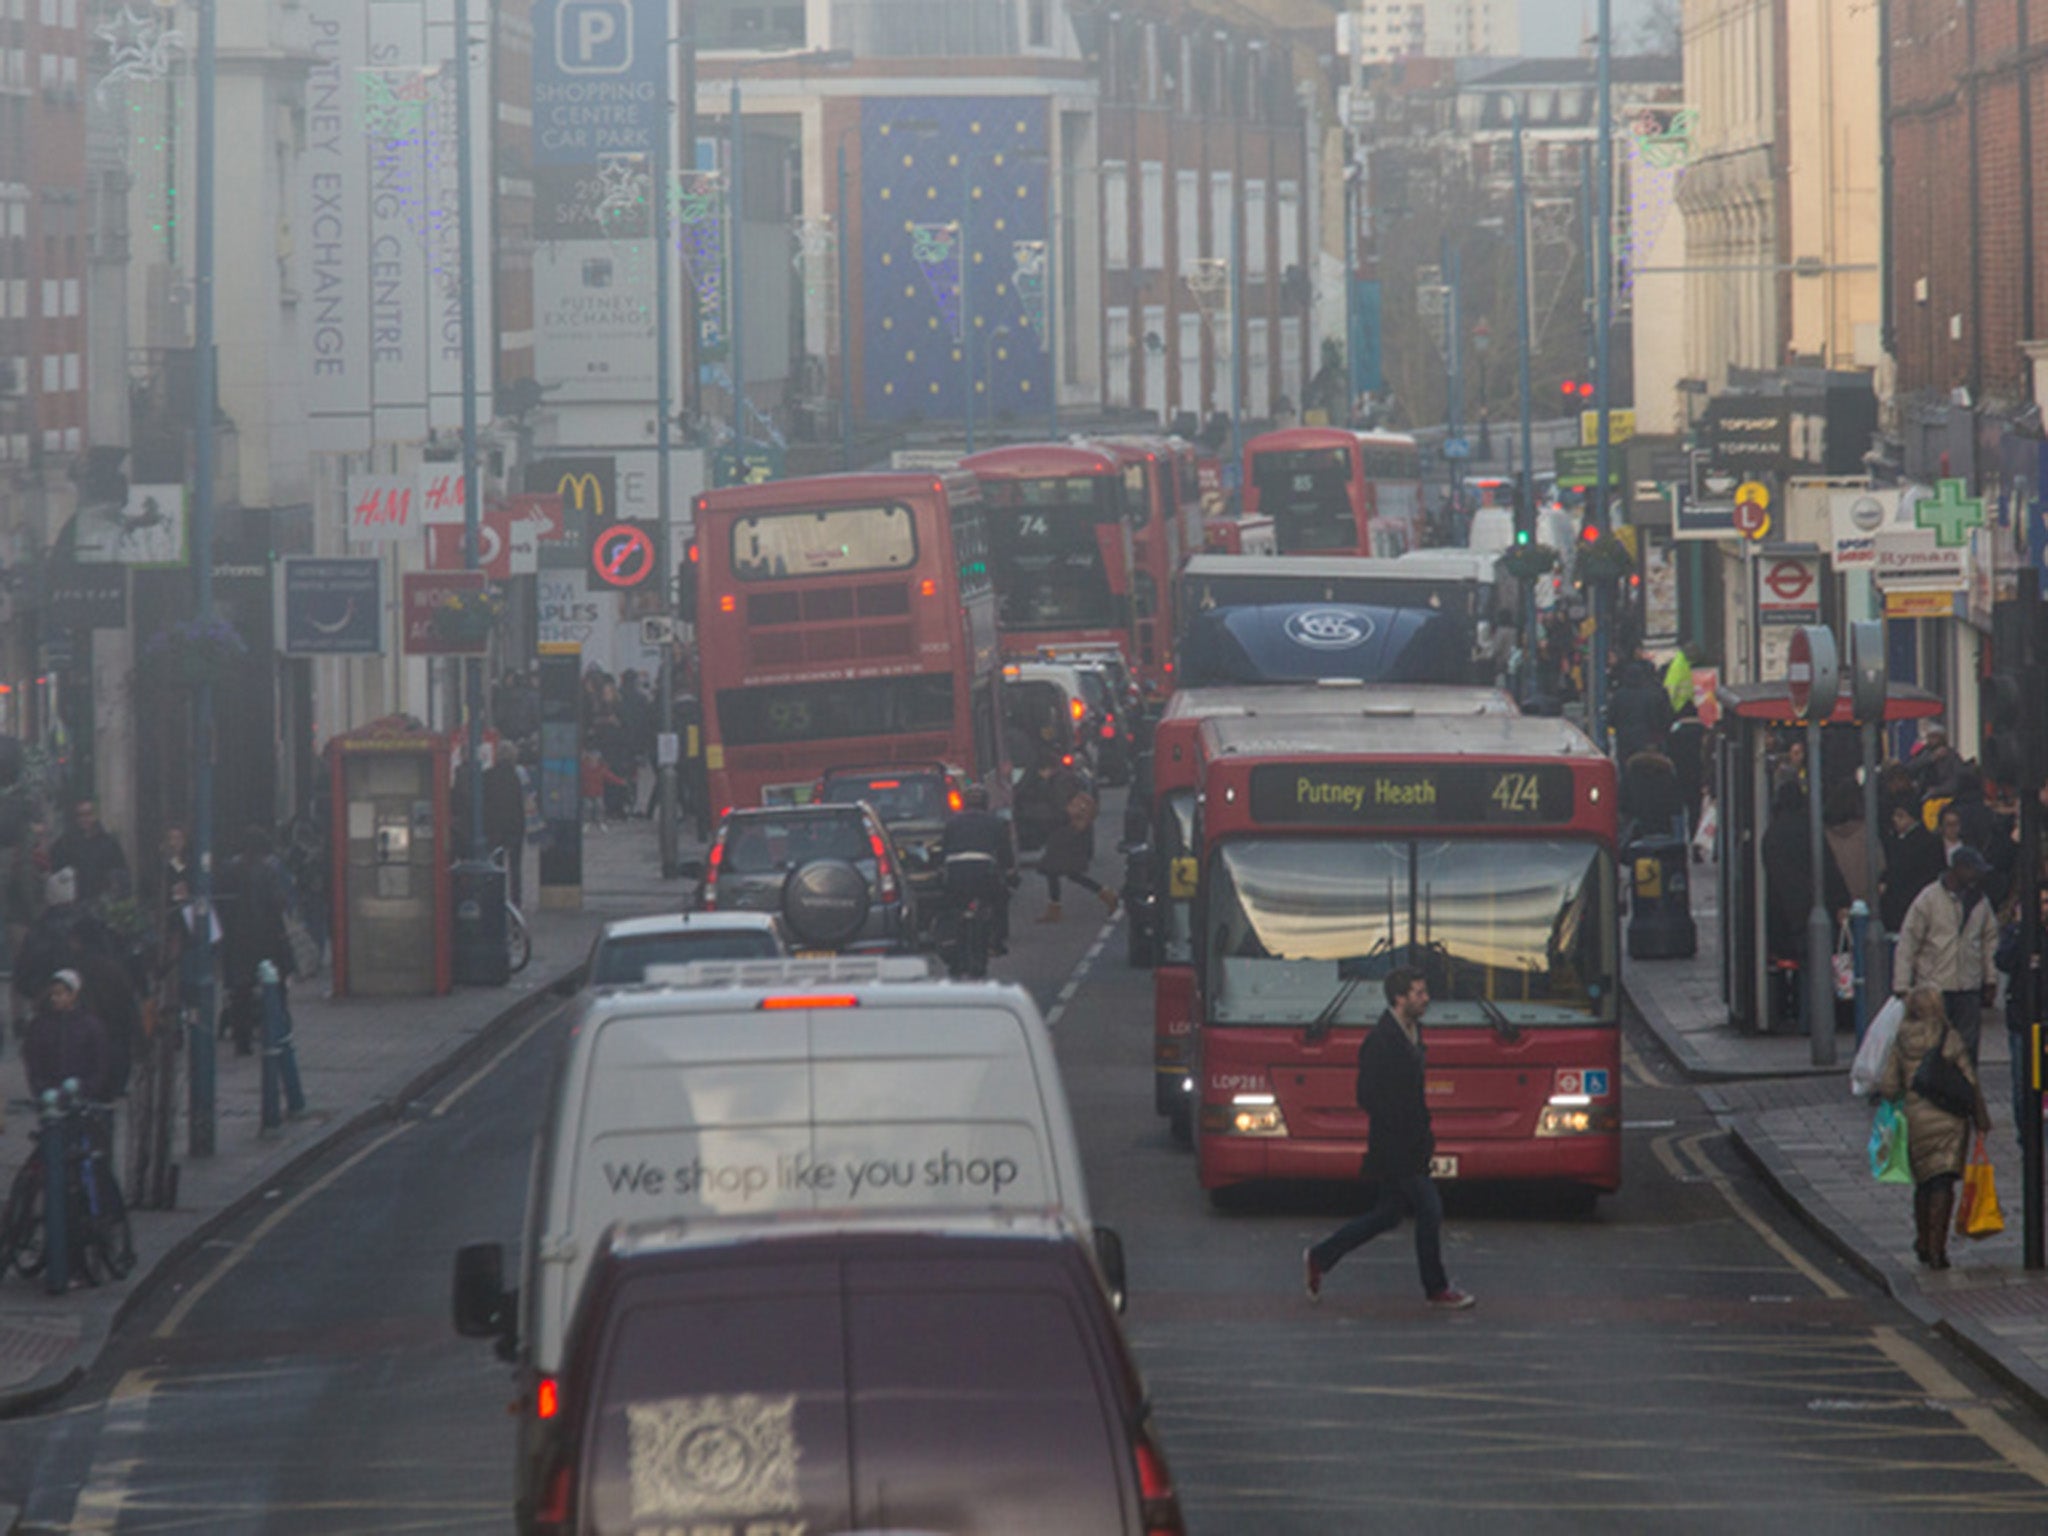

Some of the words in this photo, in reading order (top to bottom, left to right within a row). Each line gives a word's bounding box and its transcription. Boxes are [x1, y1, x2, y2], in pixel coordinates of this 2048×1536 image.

[580, 10, 614, 61] P
[311, 19, 341, 155] PUTNEY
[535, 81, 656, 101] SHOPPING
[552, 105, 641, 125] CENTRE
[541, 129, 587, 149] CAR
[597, 128, 650, 148] PARK
[311, 172, 345, 376] EXCHANGE
[373, 235, 402, 363] CENTRE
[560, 297, 636, 313] PUTNEY
[1719, 417, 1779, 431] TOPSHOP
[1718, 441, 1782, 456] TOPMAN
[353, 487, 412, 527] H&M
[1741, 506, 1757, 528] L
[1019, 516, 1048, 536] 74
[1879, 551, 1959, 566] Ryman
[1297, 777, 1366, 811] Putney
[1376, 777, 1437, 805] Heath
[1492, 773, 1541, 812] 424
[605, 1160, 665, 1196] We
[673, 1156, 769, 1201] shop
[776, 1152, 837, 1192] like
[846, 1159, 915, 1198] you
[923, 1149, 1018, 1195] shop
